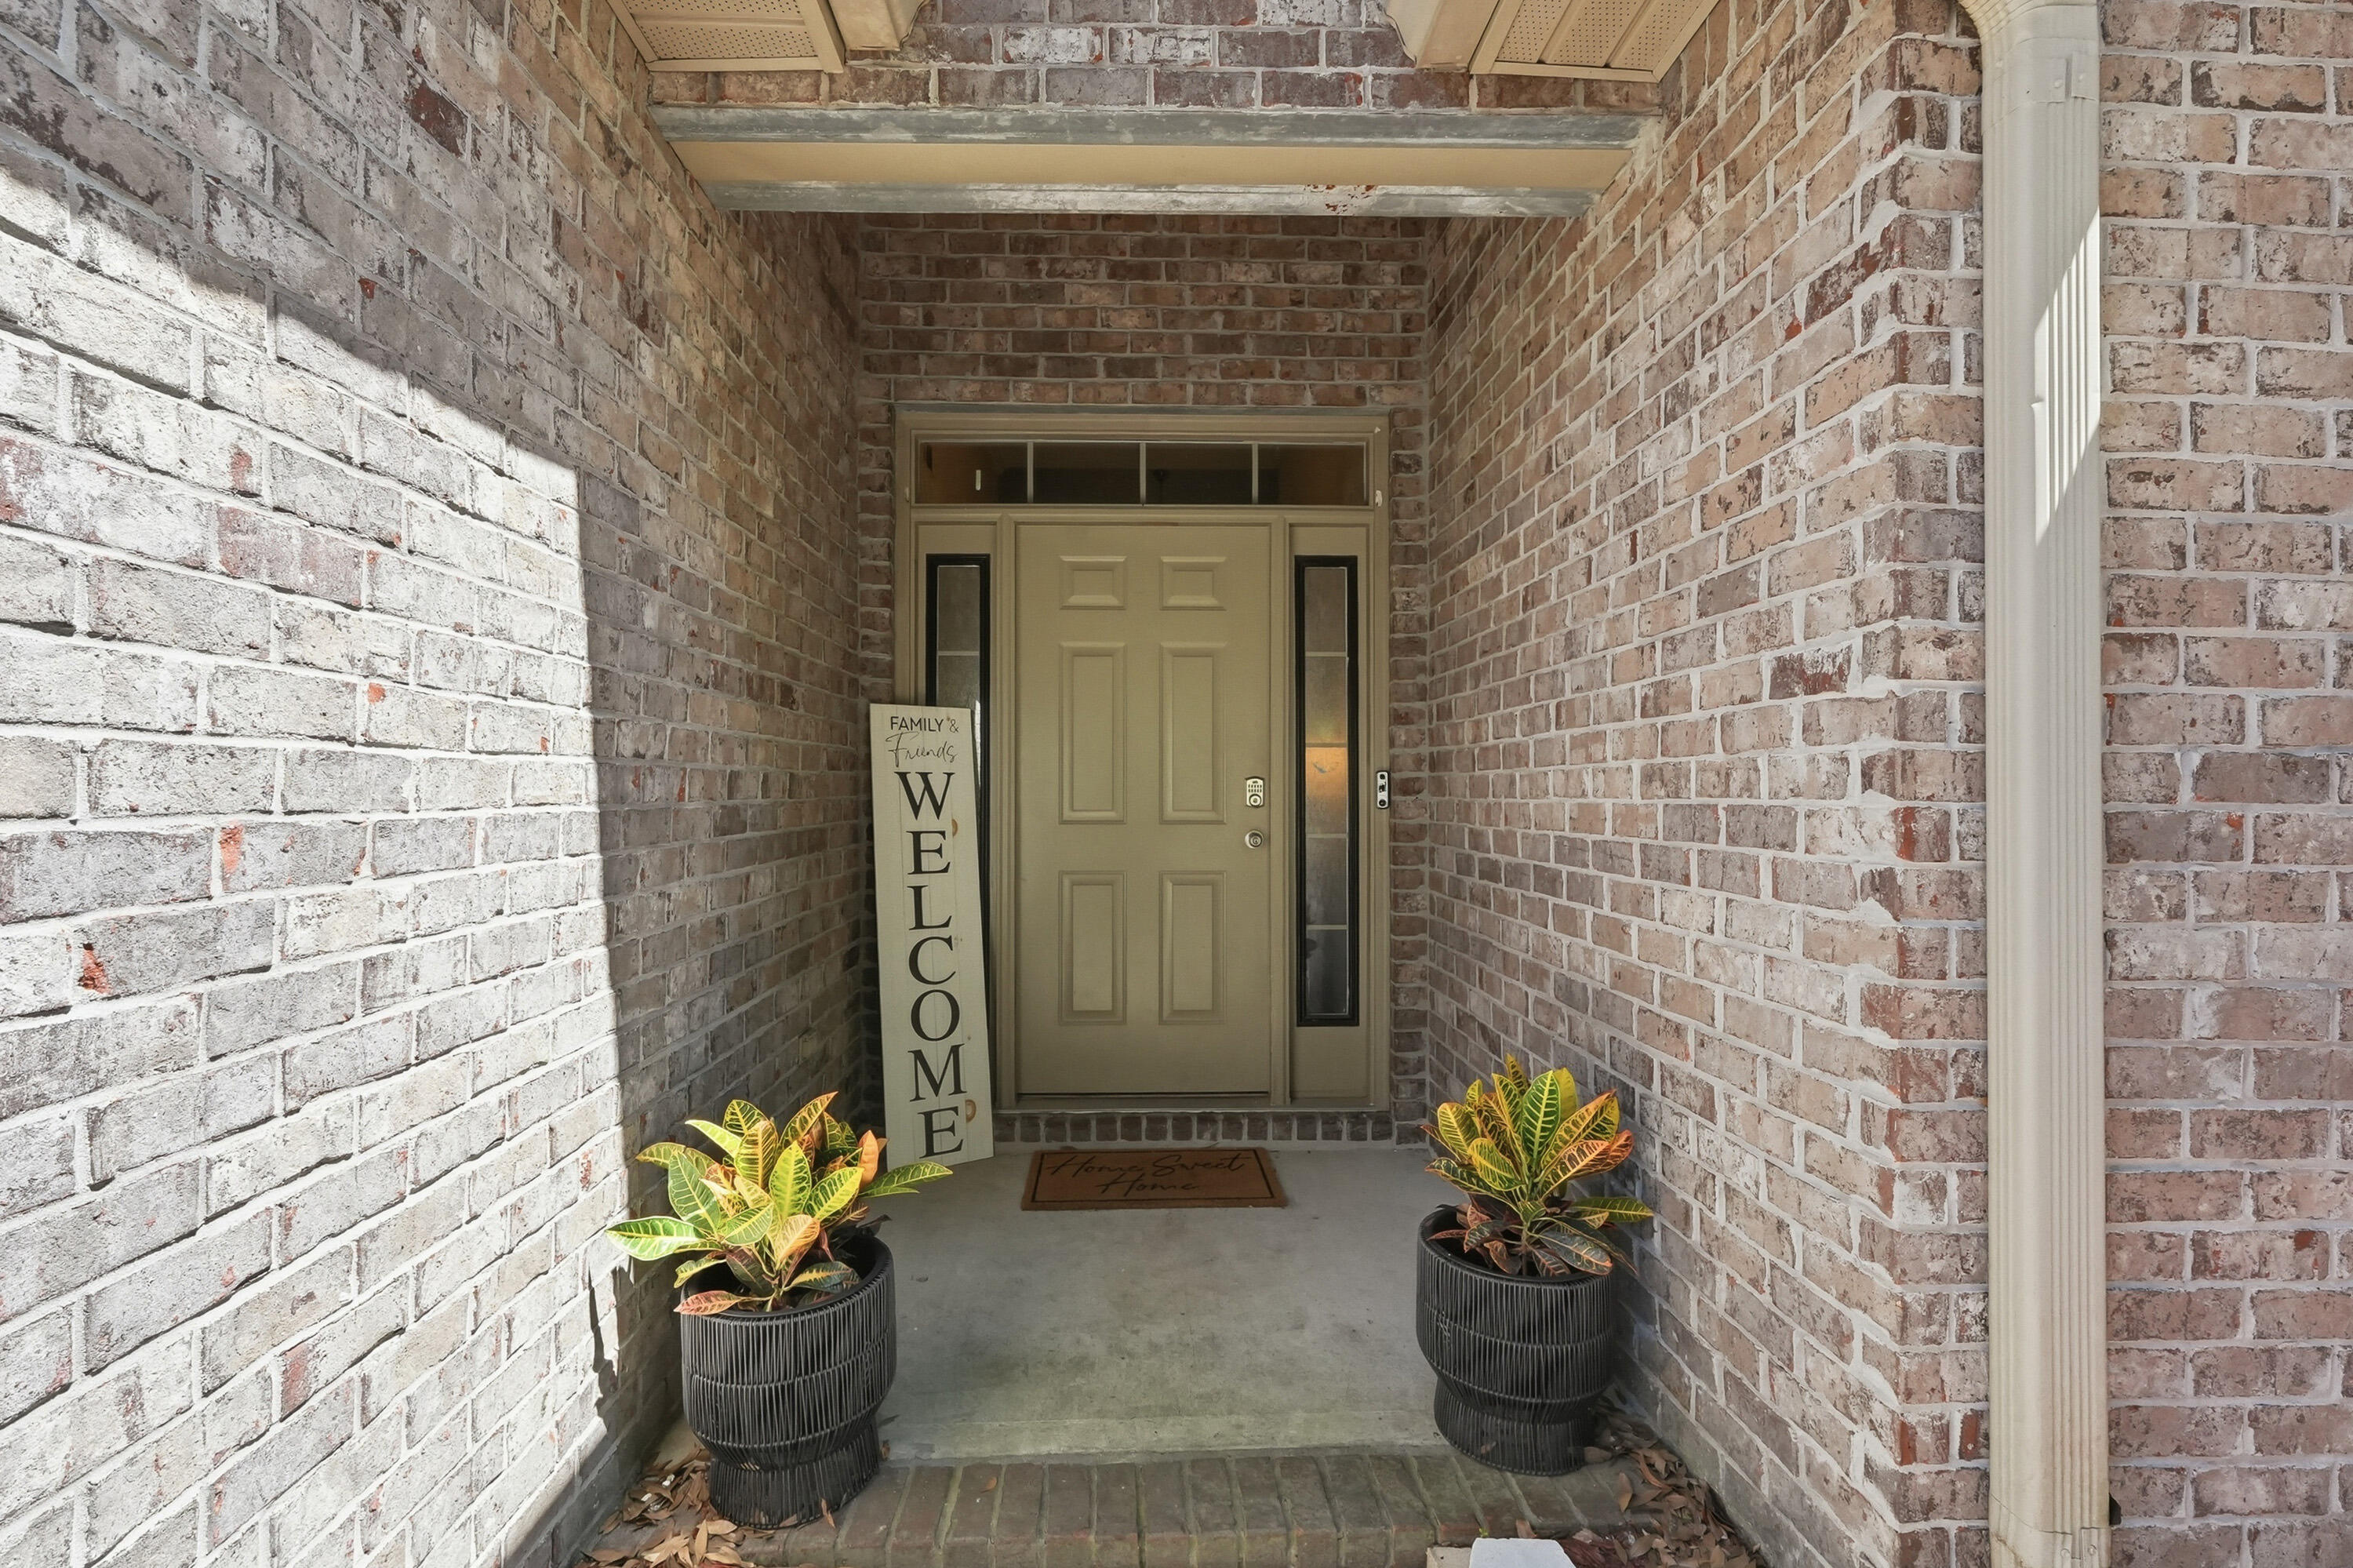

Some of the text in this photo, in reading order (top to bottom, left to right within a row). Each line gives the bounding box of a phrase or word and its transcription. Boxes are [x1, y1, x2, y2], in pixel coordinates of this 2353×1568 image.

[890, 716, 958, 733] FAMILY &
[885, 731, 957, 768] Friends
[894, 771, 968, 1159] WELCOME
[1046, 1153, 1252, 1177] Home Sweet
[1096, 1173, 1198, 1196] Home
